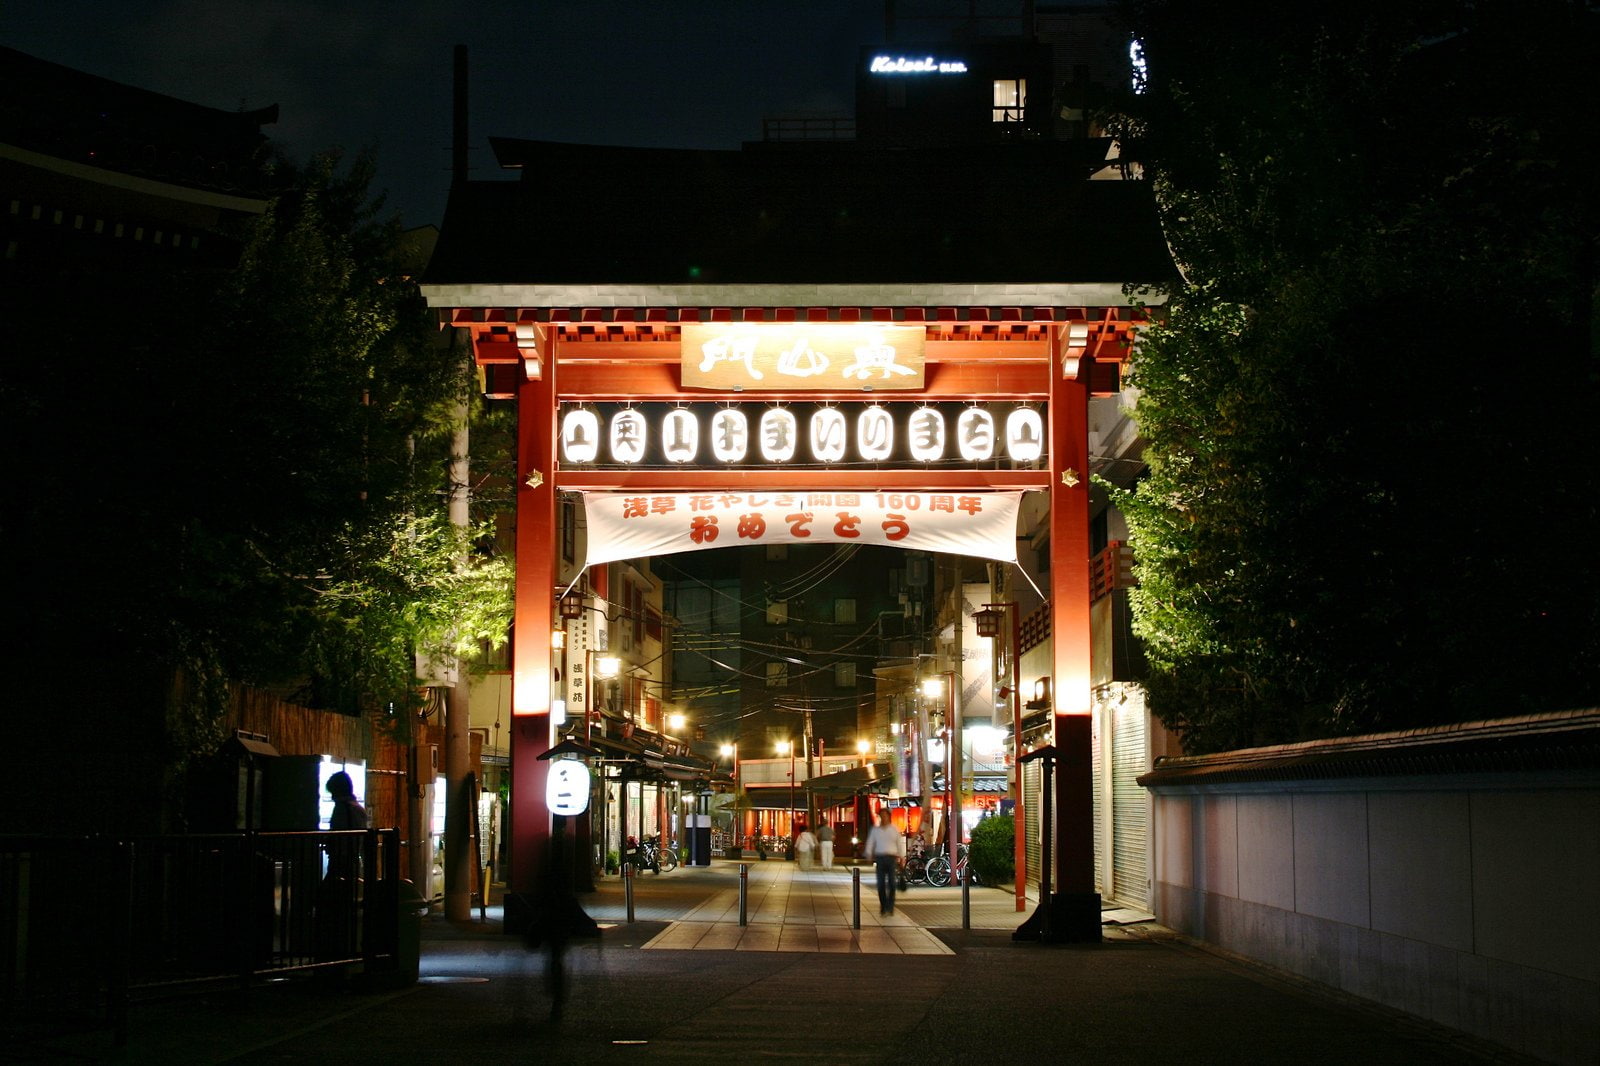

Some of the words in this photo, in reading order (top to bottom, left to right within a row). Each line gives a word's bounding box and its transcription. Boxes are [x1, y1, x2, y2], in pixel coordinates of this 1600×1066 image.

[689, 511, 911, 544] おめでとう
